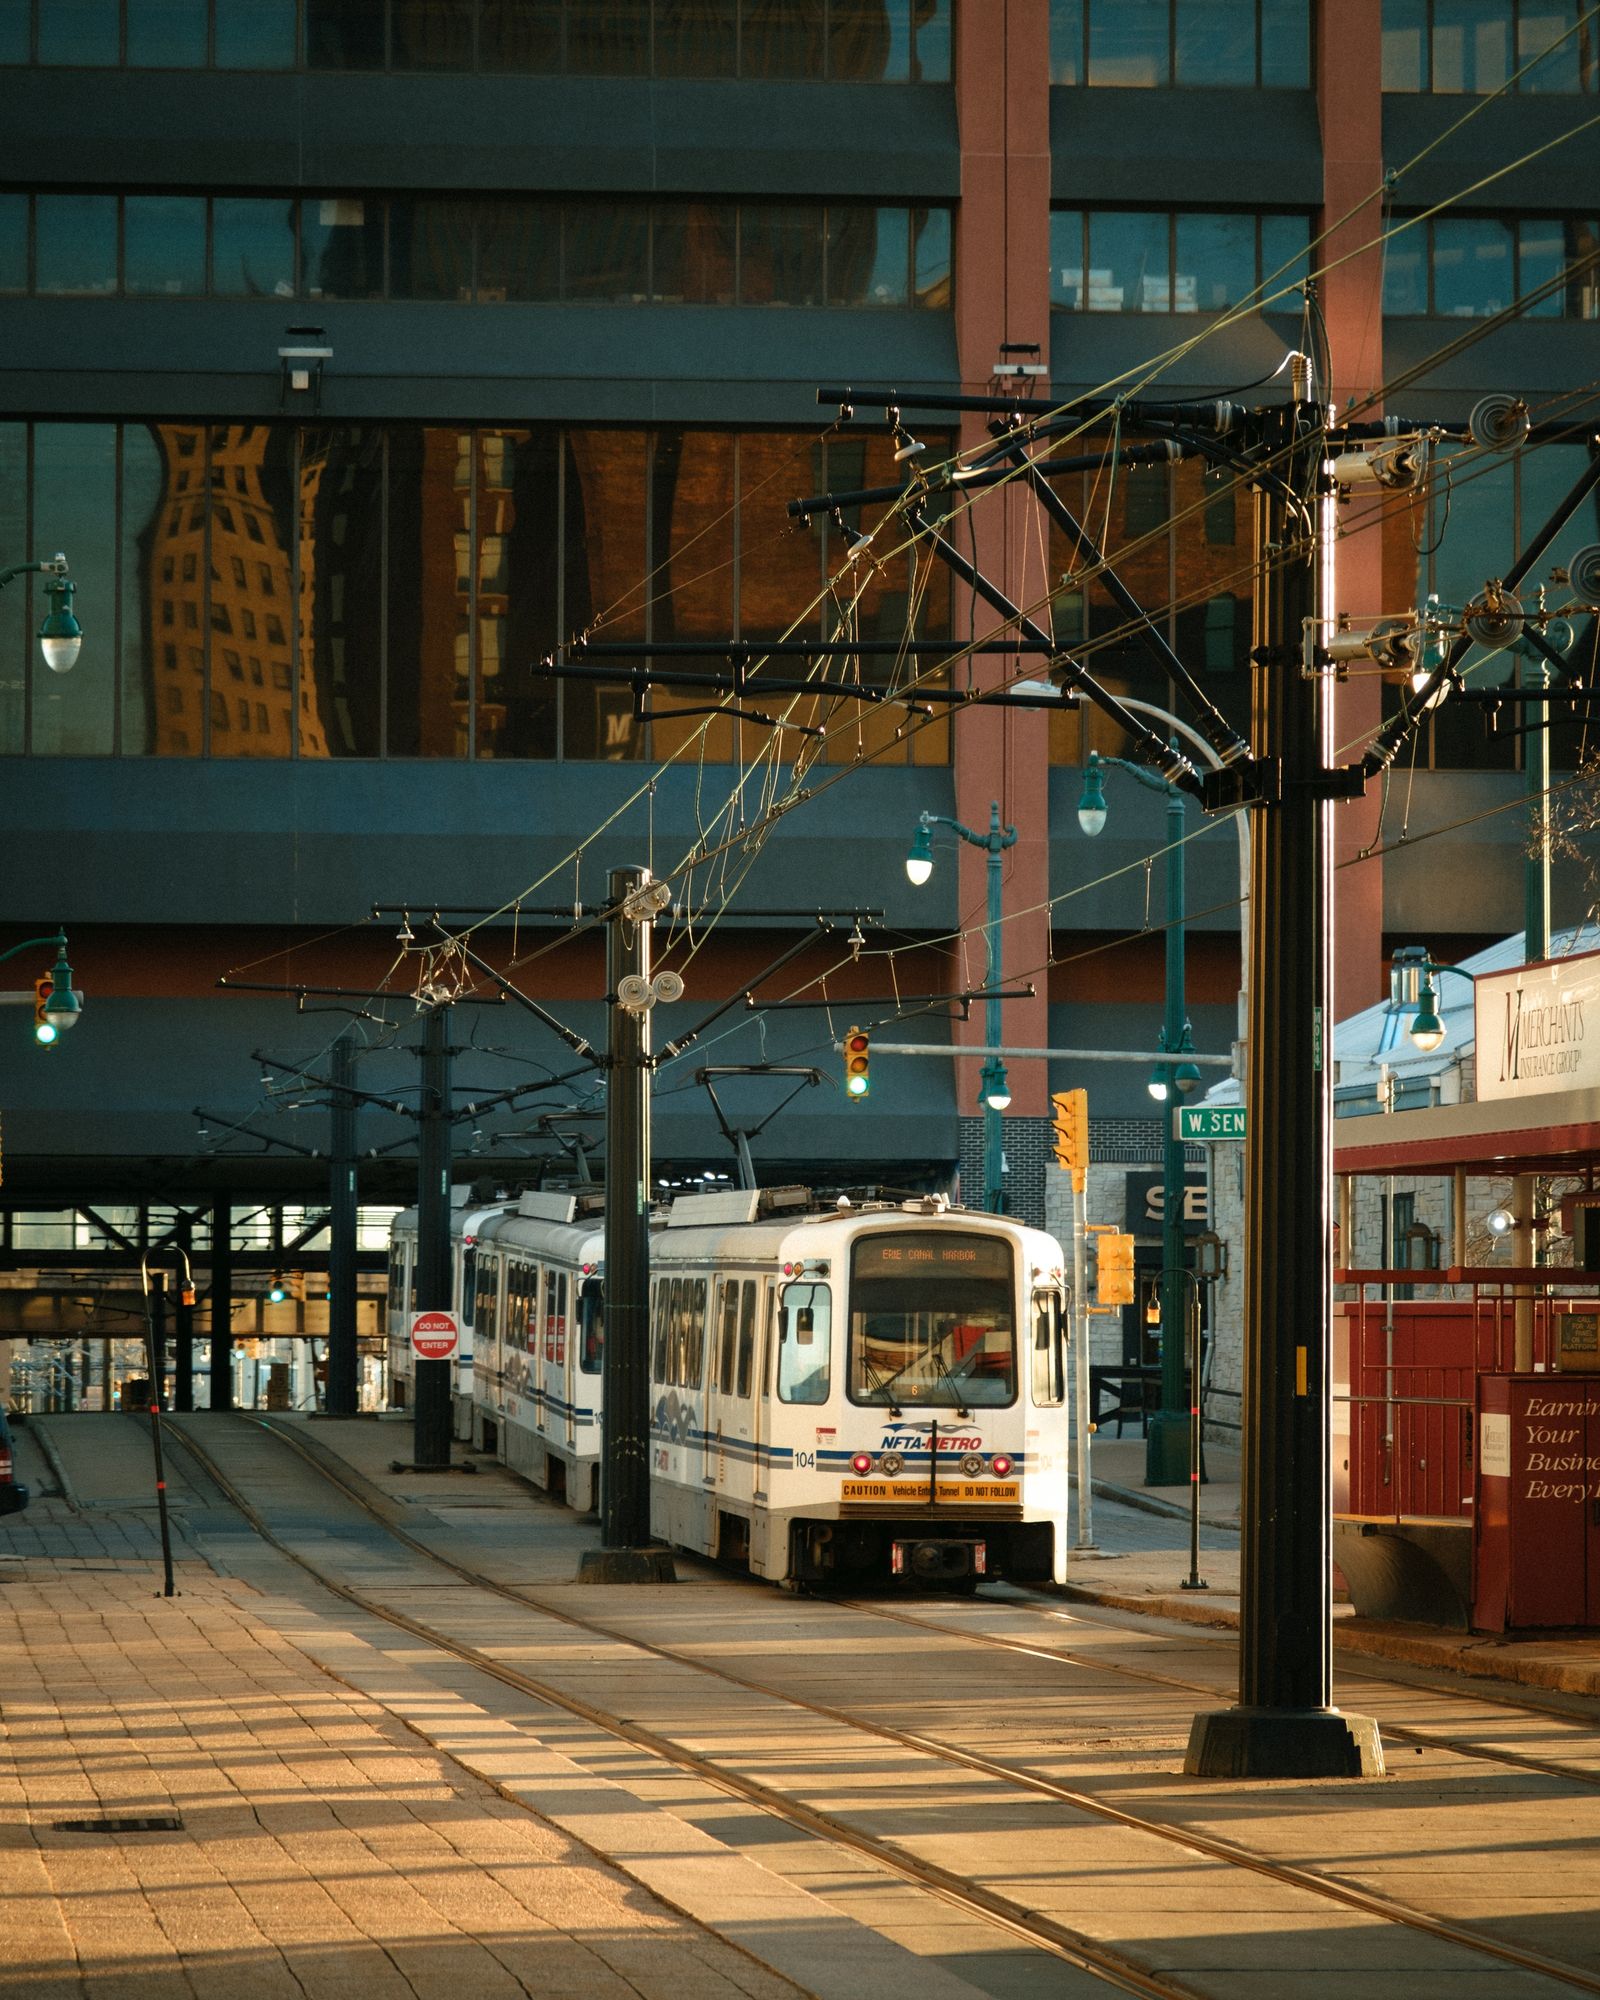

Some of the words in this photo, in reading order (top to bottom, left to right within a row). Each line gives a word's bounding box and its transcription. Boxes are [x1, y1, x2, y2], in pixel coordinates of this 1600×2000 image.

[1520, 1000, 1584, 1050] MERCHANTS
[1520, 1053, 1555, 1079] INSURANCE
[1188, 1114, 1206, 1132] W.
[882, 1249, 902, 1260] ERIE
[907, 1249, 935, 1260] CANAL
[942, 1249, 977, 1261] HARBOR
[419, 1322, 431, 1330] DO
[433, 1322, 450, 1330] NOT
[1526, 1425, 1580, 1444] Your
[795, 1452, 815, 1468] 104
[843, 1485, 887, 1496] CAUTION
[893, 1485, 917, 1496] Vehicle
[940, 1486, 960, 1498] Tunnel
[965, 1487, 974, 1497] DO
[976, 1487, 988, 1497] NOT
[990, 1487, 1016, 1497] FOLLOW
[1525, 1481, 1592, 1503] Every
